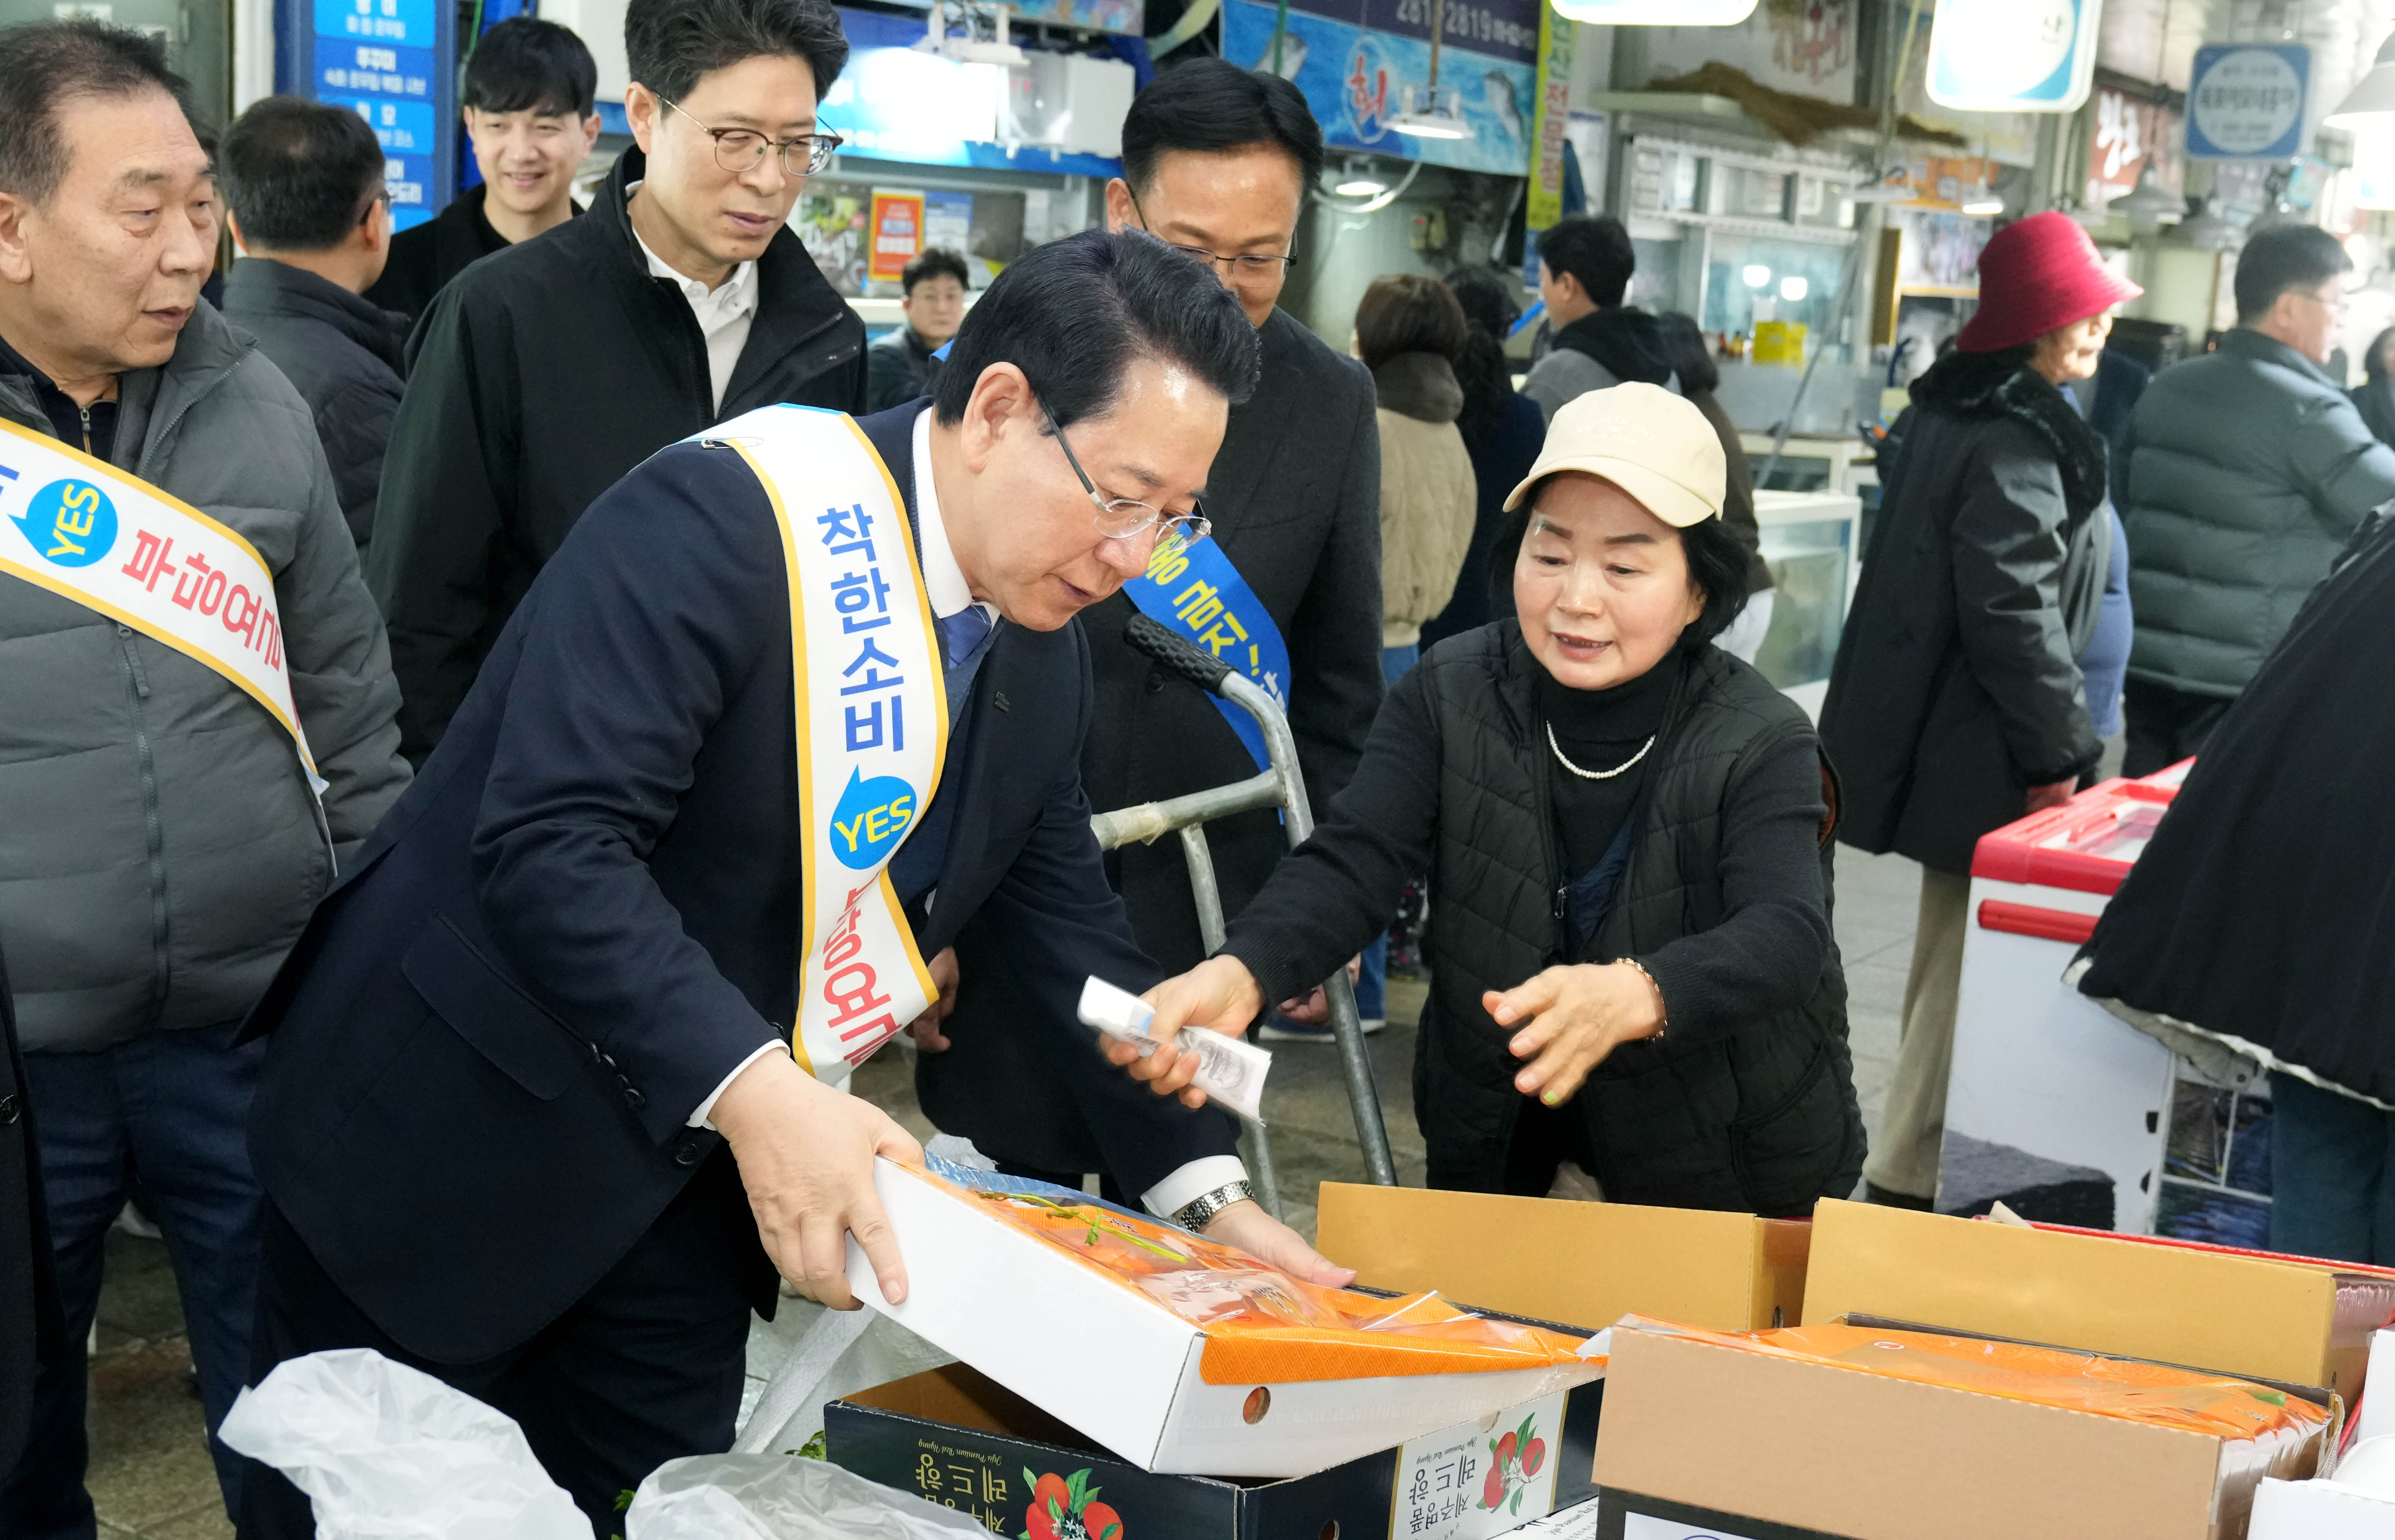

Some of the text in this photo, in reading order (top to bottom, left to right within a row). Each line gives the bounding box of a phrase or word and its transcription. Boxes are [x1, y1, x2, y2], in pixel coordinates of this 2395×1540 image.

[47, 484, 99, 557] YES
[122, 529, 281, 671] 부당요금
[816, 504, 904, 752] 착한소비
[1172, 579, 1259, 676] 금지!
[834, 795, 912, 853] YES
[918, 1439, 1002, 1466] Jeju Premium Red Hyang
[1416, 1437, 1477, 1465] Jeju Premium Red Hyang
[915, 1454, 1007, 1504] 레드향
[1409, 1454, 1476, 1505] 레드향
[1410, 1492, 1470, 1535] 제주명품
[1555, 1514, 1584, 1527] Premium
